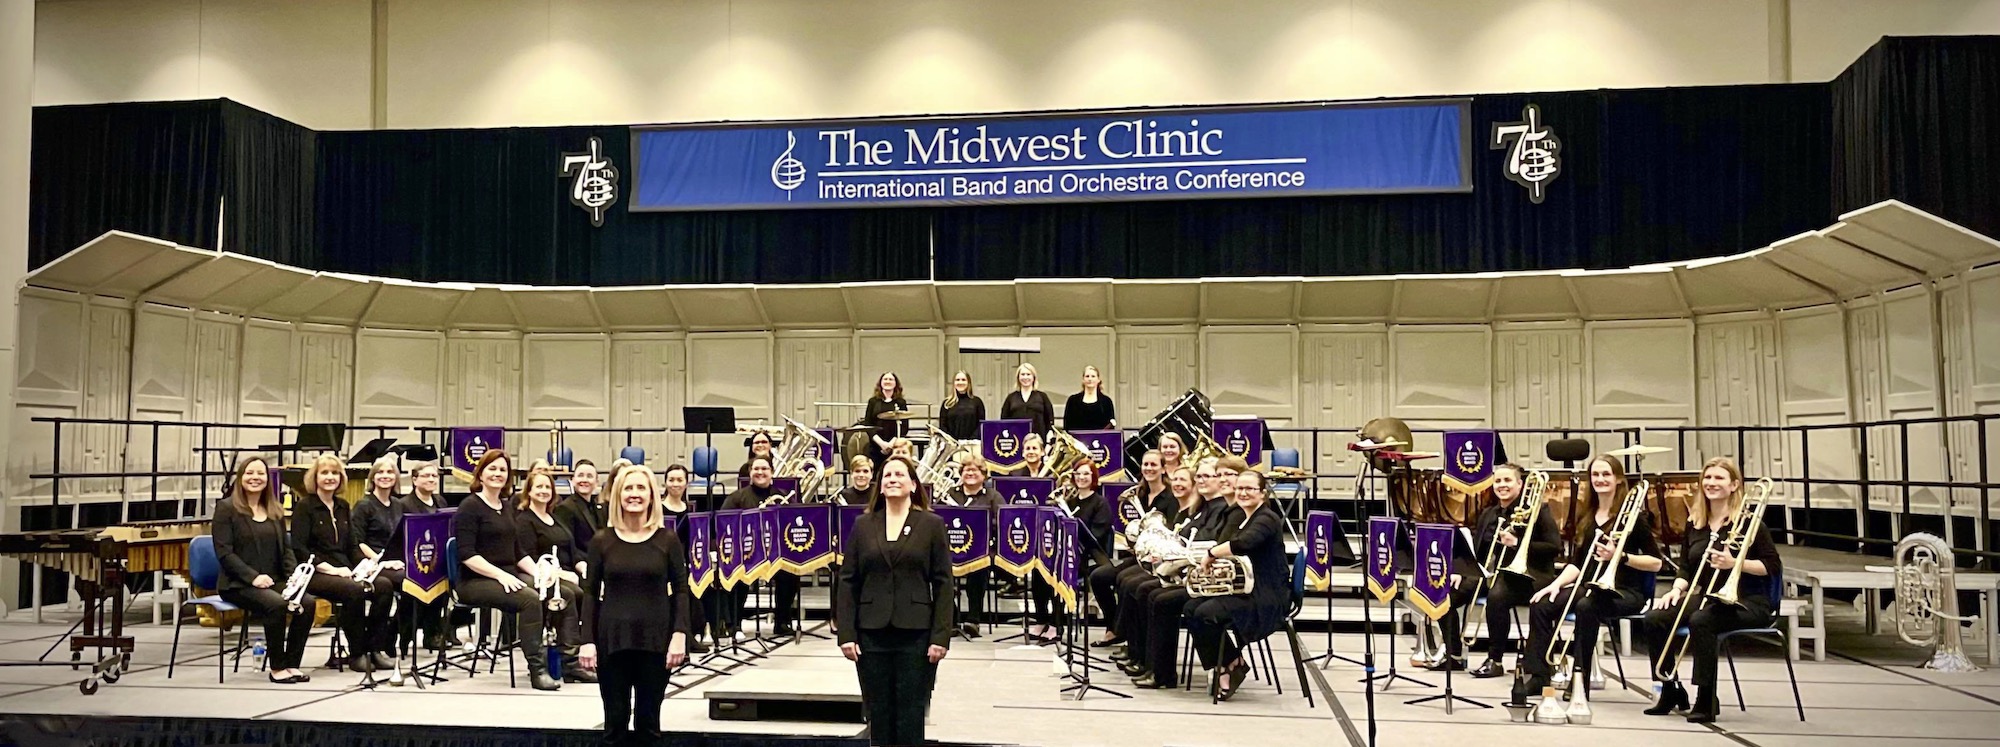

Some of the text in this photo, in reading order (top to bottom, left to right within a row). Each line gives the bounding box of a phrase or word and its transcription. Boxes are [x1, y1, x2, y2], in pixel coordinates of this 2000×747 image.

[818, 118, 1223, 167] The Midwest Clinic
[818, 168, 1305, 199] International Band and Orchestra Conference
